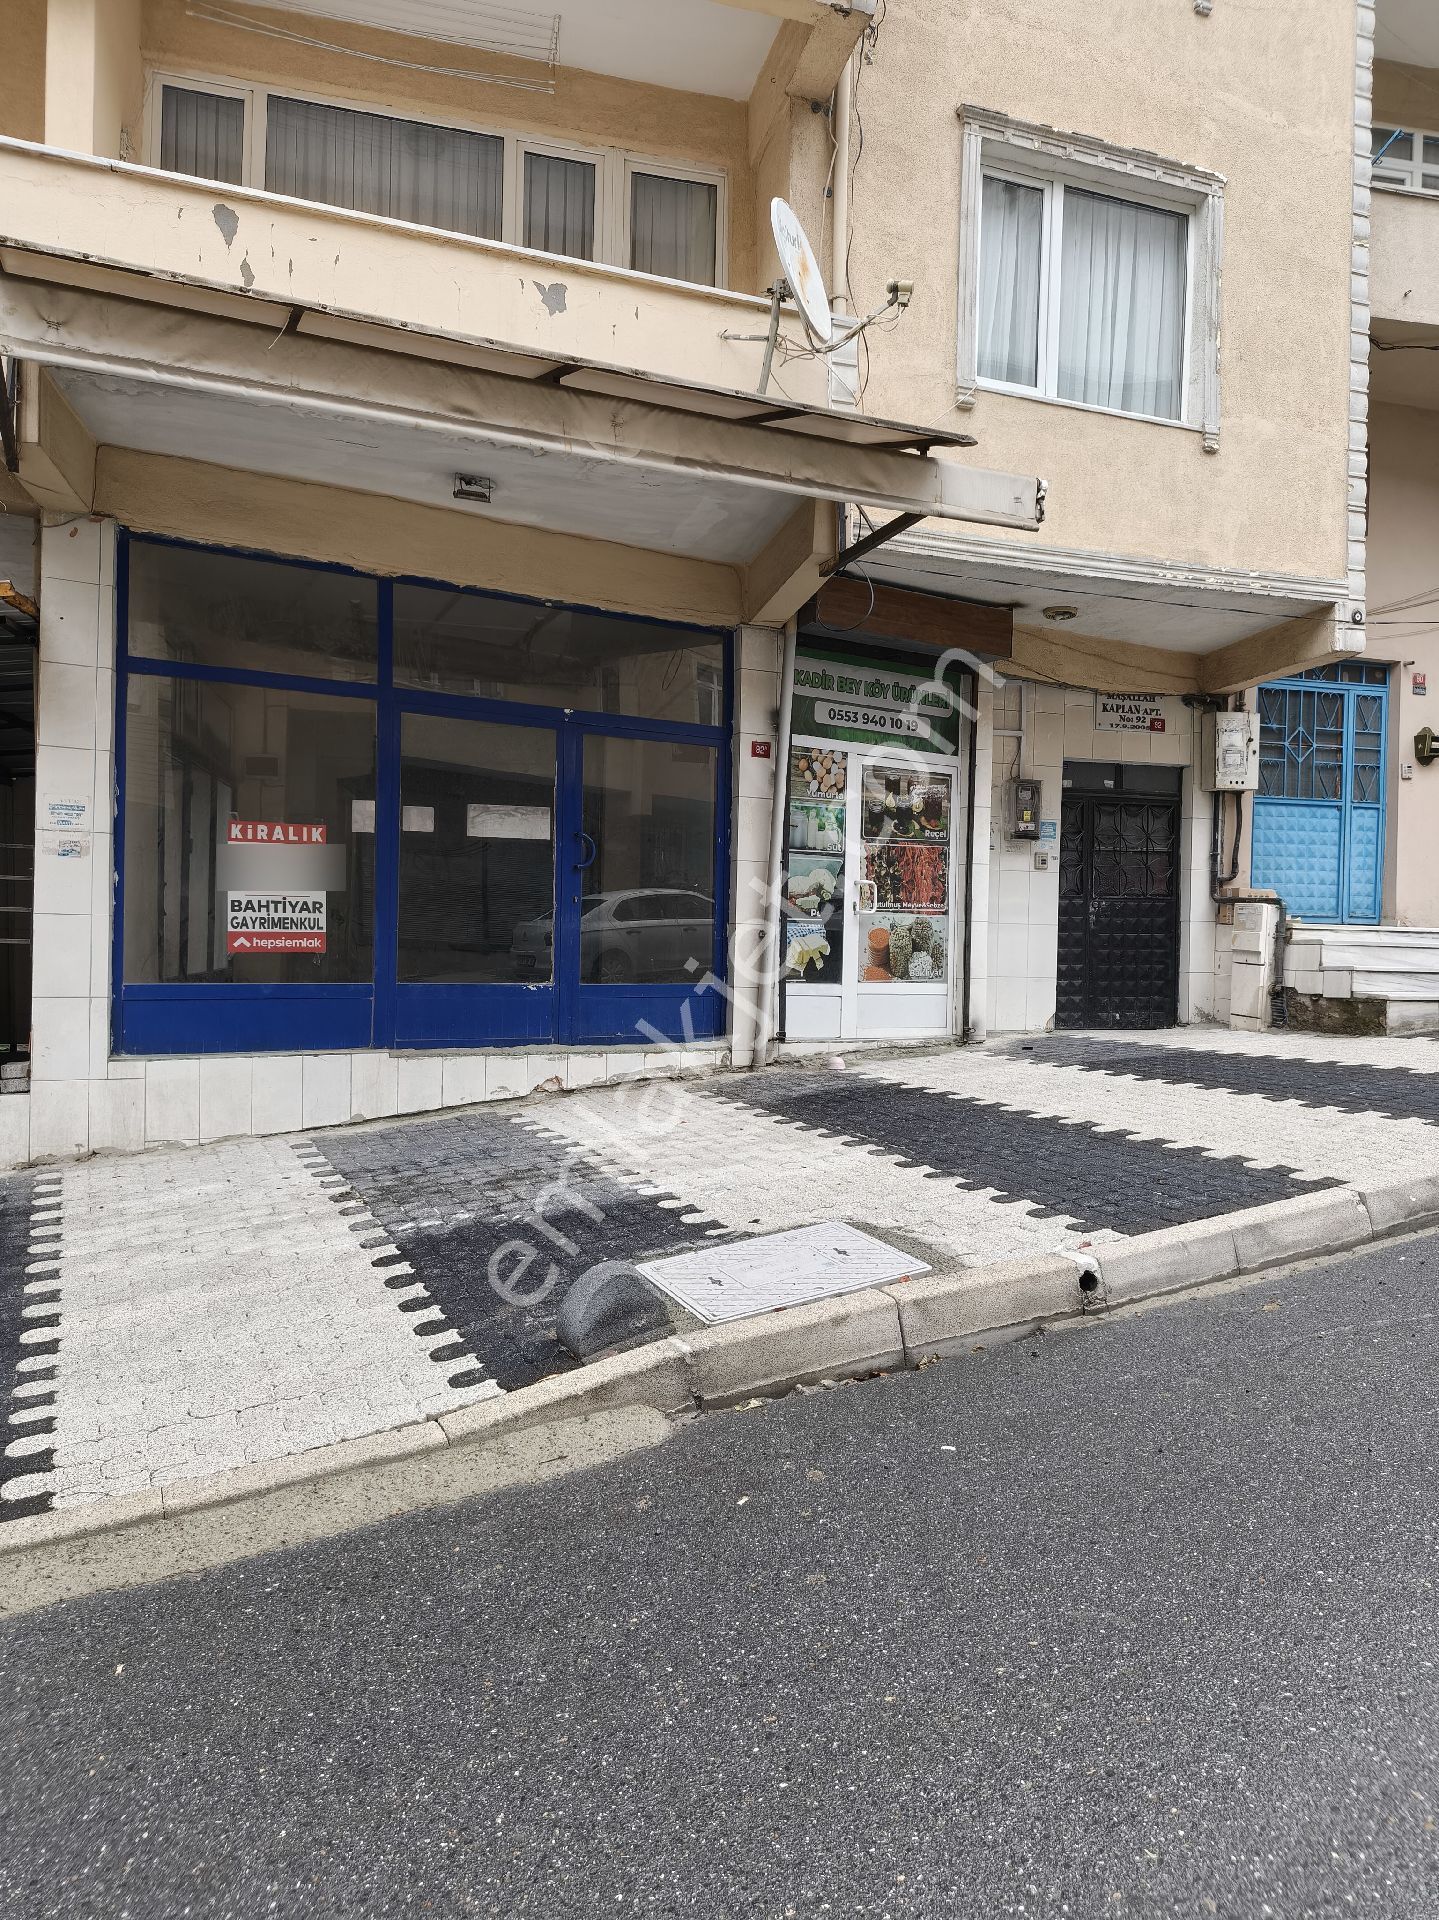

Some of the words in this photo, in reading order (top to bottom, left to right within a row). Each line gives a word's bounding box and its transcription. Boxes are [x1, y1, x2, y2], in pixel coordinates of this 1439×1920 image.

[793, 668, 835, 691] KADİR
[837, 675, 862, 695] BEY
[864, 679, 891, 699] KÖY
[1101, 703, 1141, 714] KAPLAN
[828, 708, 859, 724] 0553
[861, 712, 887, 728] 940
[889, 716, 902, 730] 10
[906, 719, 919, 732] 19
[1135, 715, 1147, 723] 92
[806, 788, 844, 800] Yumurta
[924, 829, 947, 840] Reçel
[827, 842, 842, 851] Süt
[230, 896, 324, 914] BAHTİYAR
[230, 913, 324, 931] GAYRİMENKUL
[252, 936, 322, 949] hepsiemlak
